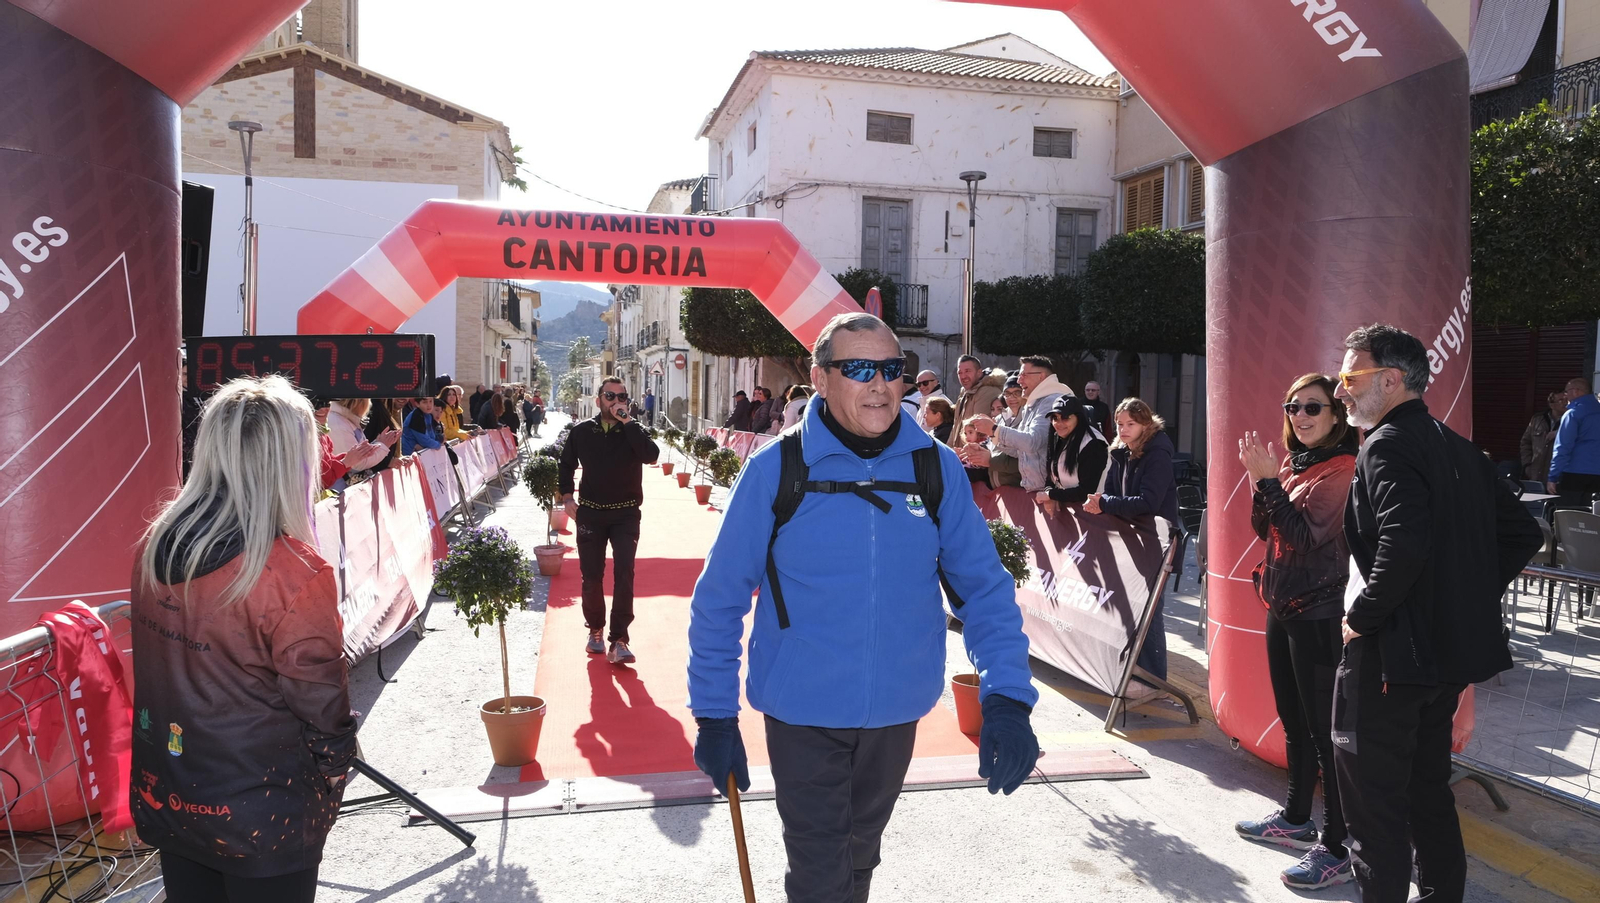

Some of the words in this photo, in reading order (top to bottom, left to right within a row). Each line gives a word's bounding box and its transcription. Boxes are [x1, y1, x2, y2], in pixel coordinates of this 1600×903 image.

[1290, 0, 1383, 62] RGY
[497, 209, 715, 237] AYUNTAMIENTO
[503, 236, 707, 277] CANTORIA
[183, 801, 231, 816] VEOLIA
